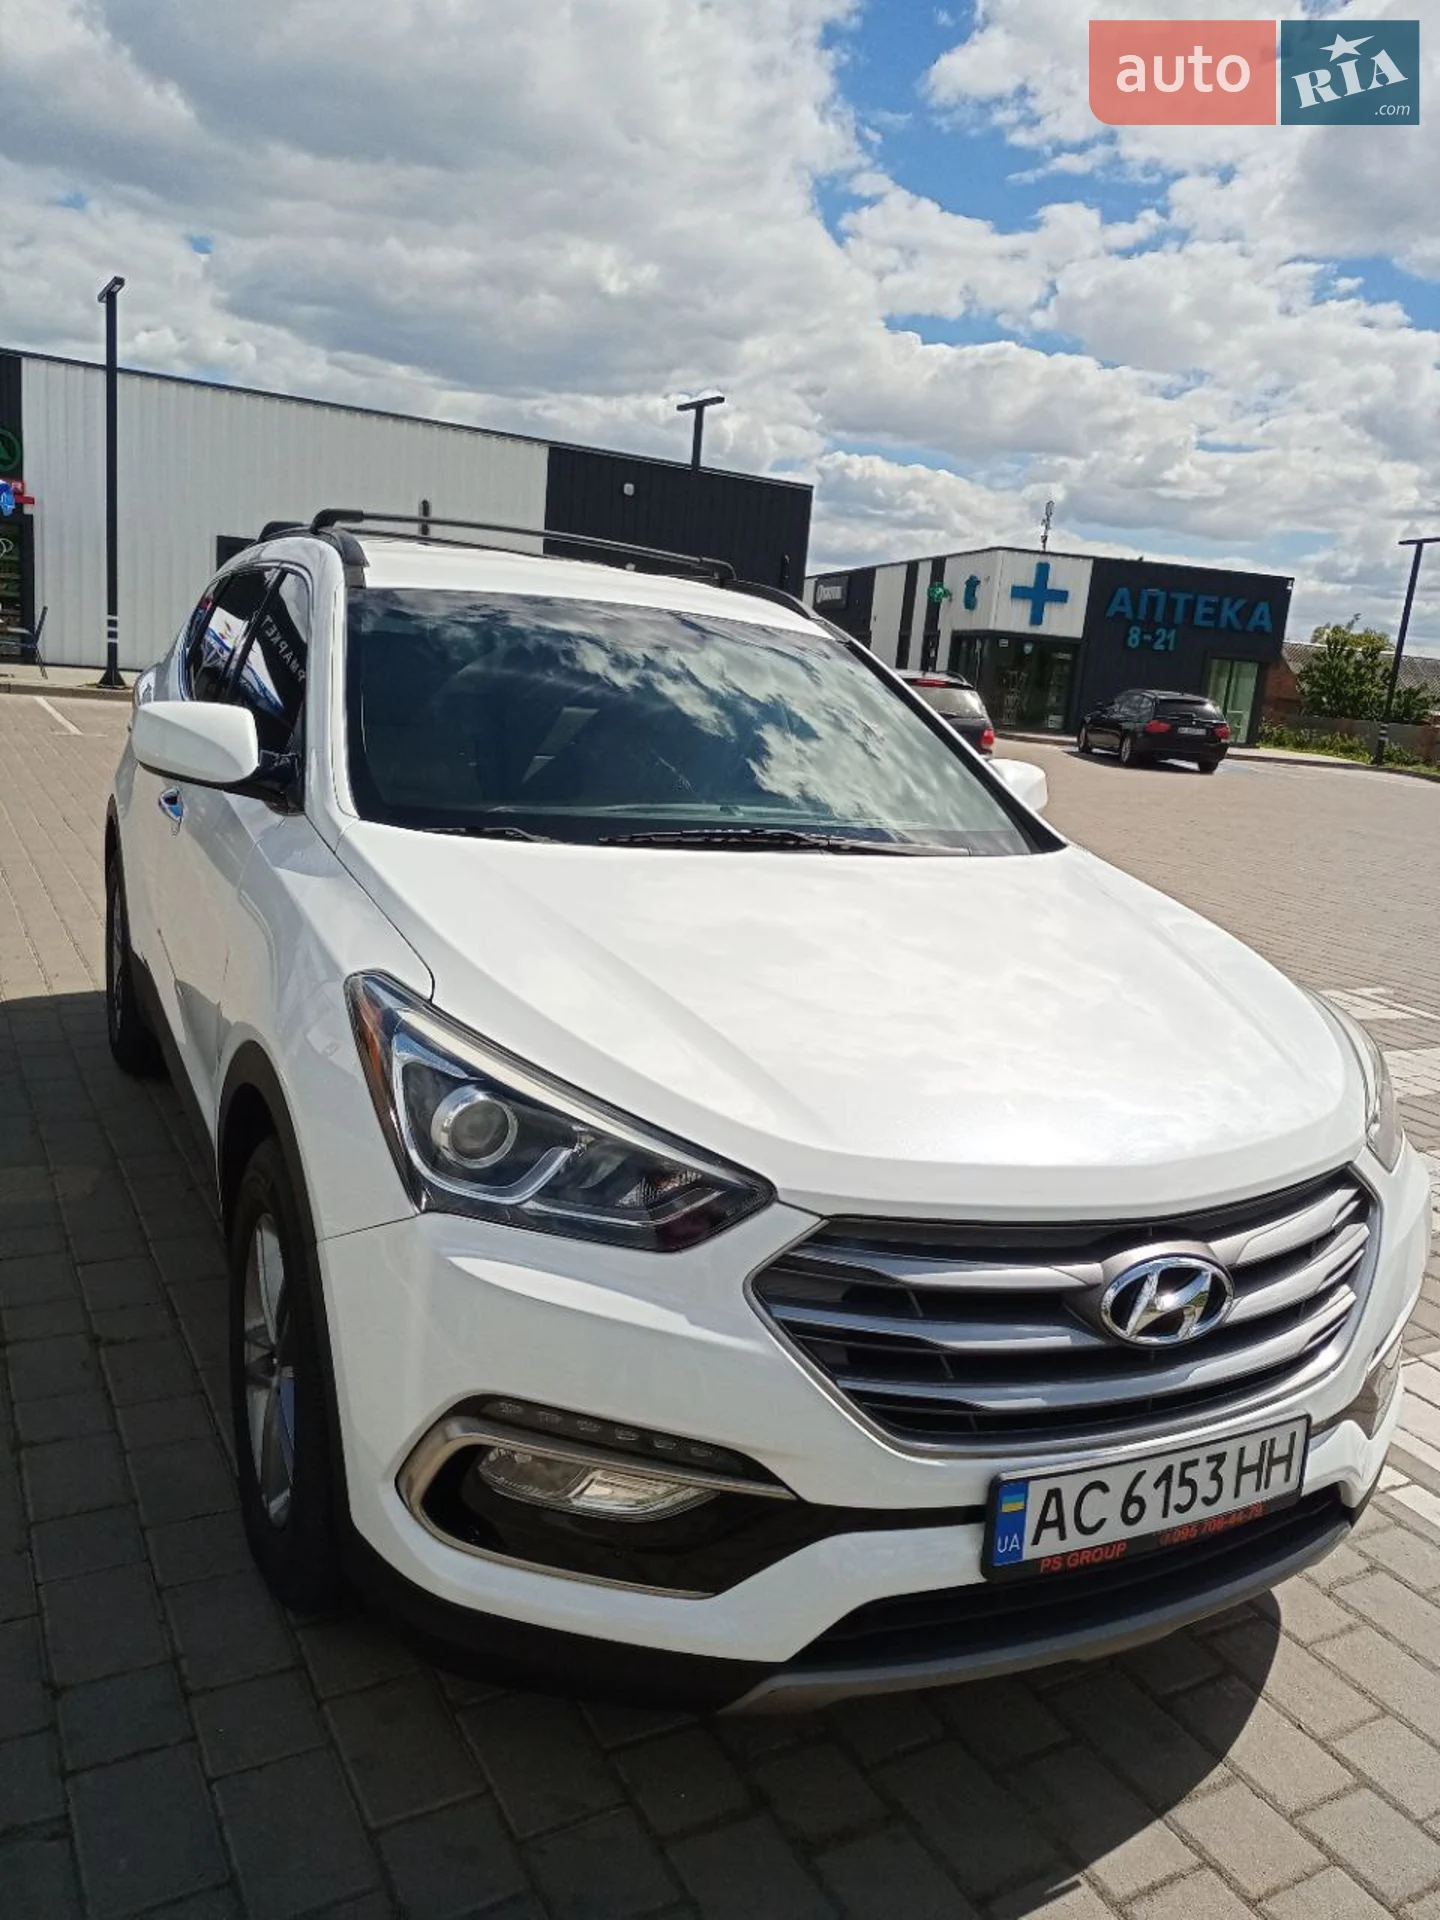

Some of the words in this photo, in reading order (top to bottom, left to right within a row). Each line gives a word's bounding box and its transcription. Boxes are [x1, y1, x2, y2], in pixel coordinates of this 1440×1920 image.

[1106, 587, 1273, 633] АПТЕКА
[1127, 625, 1177, 651] 8-21
[997, 1533, 1020, 1553] UA
[1040, 1556, 1063, 1573] PS
[1067, 1541, 1128, 1568] GROUP
